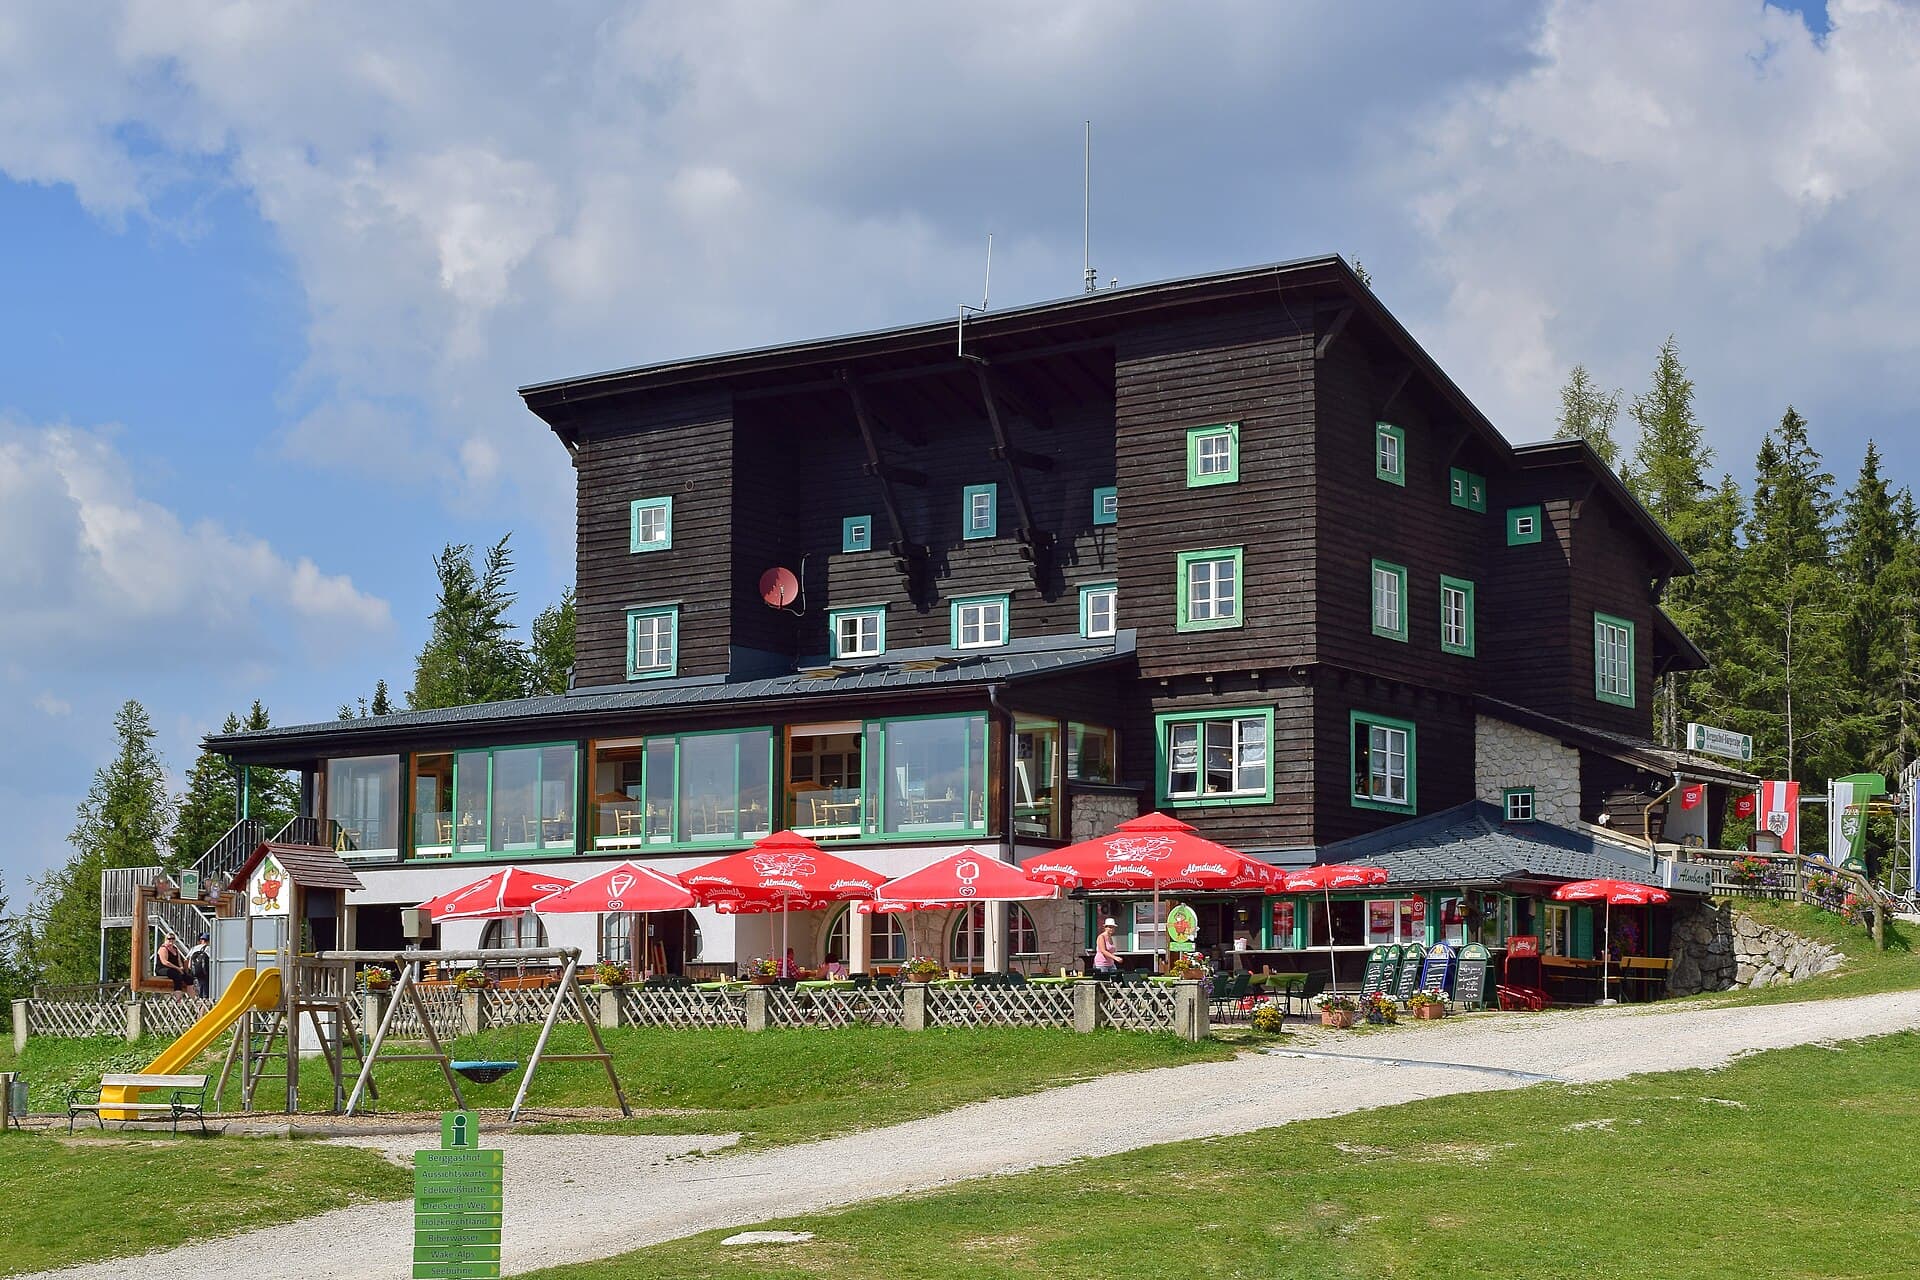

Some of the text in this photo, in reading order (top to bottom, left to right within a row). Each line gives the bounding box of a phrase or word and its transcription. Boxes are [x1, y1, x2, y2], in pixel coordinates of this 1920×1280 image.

[1032, 863, 1080, 876] Almdudler
[1107, 863, 1153, 877] Almdudler
[1181, 863, 1228, 876] Almdudler
[689, 875, 733, 885] Almdudler
[759, 878, 804, 889] Almdudler
[829, 878, 873, 890] Almdudler
[428, 1153, 481, 1164] Berggasthof
[422, 1169, 487, 1178] Aussichtswarte
[421, 1216, 488, 1226] Holzknechtland
[428, 1234, 478, 1242] Biberwasser
